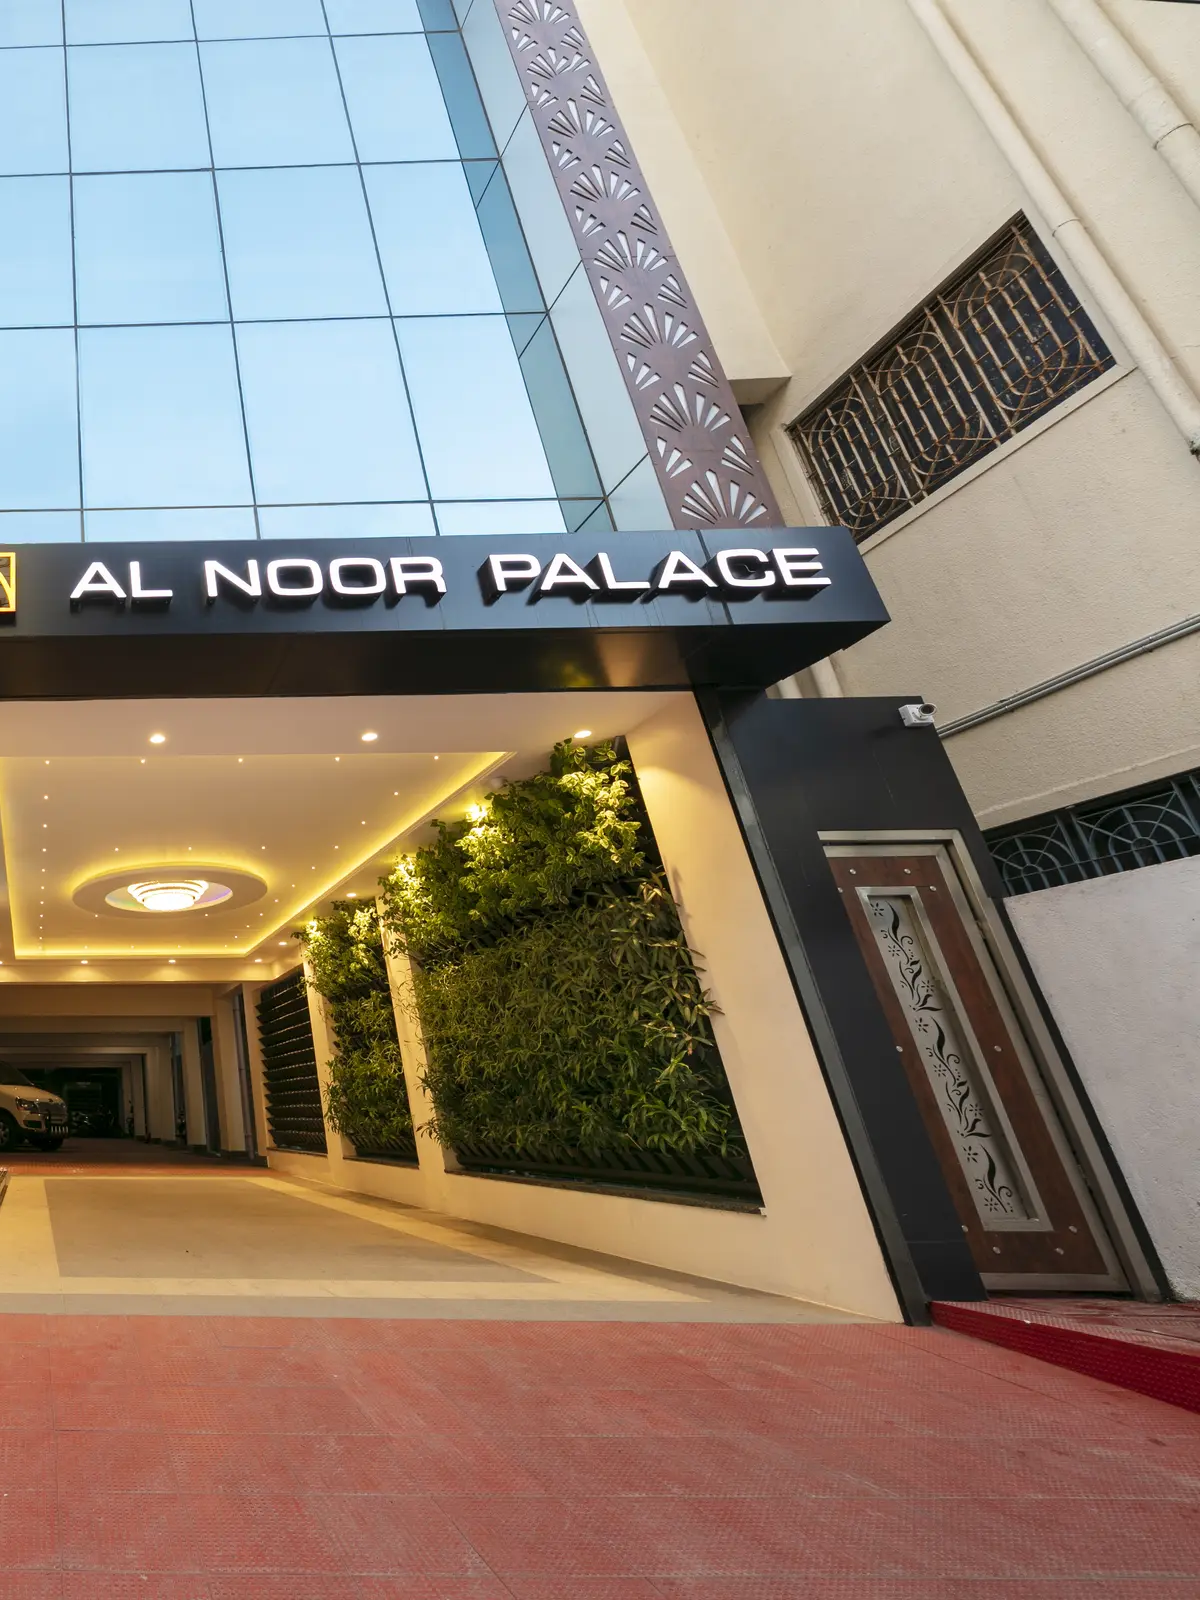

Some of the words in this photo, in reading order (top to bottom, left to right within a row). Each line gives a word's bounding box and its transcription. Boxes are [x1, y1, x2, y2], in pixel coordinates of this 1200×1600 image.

[69, 560, 174, 599] AL
[203, 556, 447, 597] NOOR
[488, 547, 833, 592] PALACE
